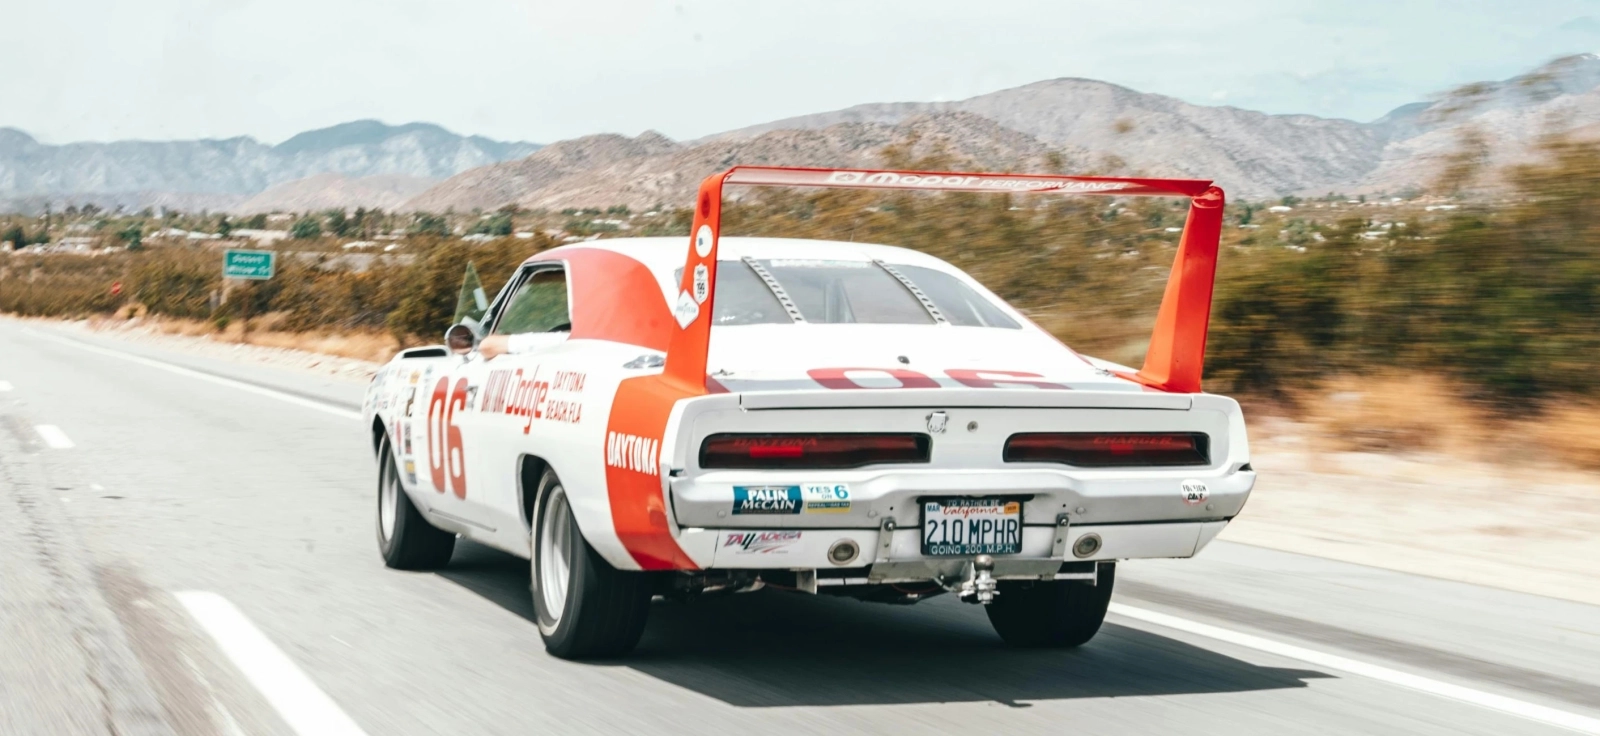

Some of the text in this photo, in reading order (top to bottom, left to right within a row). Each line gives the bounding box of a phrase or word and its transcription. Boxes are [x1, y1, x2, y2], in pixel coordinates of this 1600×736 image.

[865, 172, 1128, 190] Mopar PERFORMANCE
[552, 370, 586, 392] DAYTONA
[505, 364, 549, 435] Dodge
[427, 375, 468, 501] 06
[1093, 436, 1173, 445] CHARGER
[607, 430, 659, 477] DAYTONA
[747, 490, 789, 501] PALIN
[807, 485, 849, 500] YES 6
[927, 504, 940, 512] MAR
[943, 505, 999, 518] California
[723, 530, 802, 551] TALLADEGA
[931, 544, 1015, 555] GOING 200 M.P.H.
